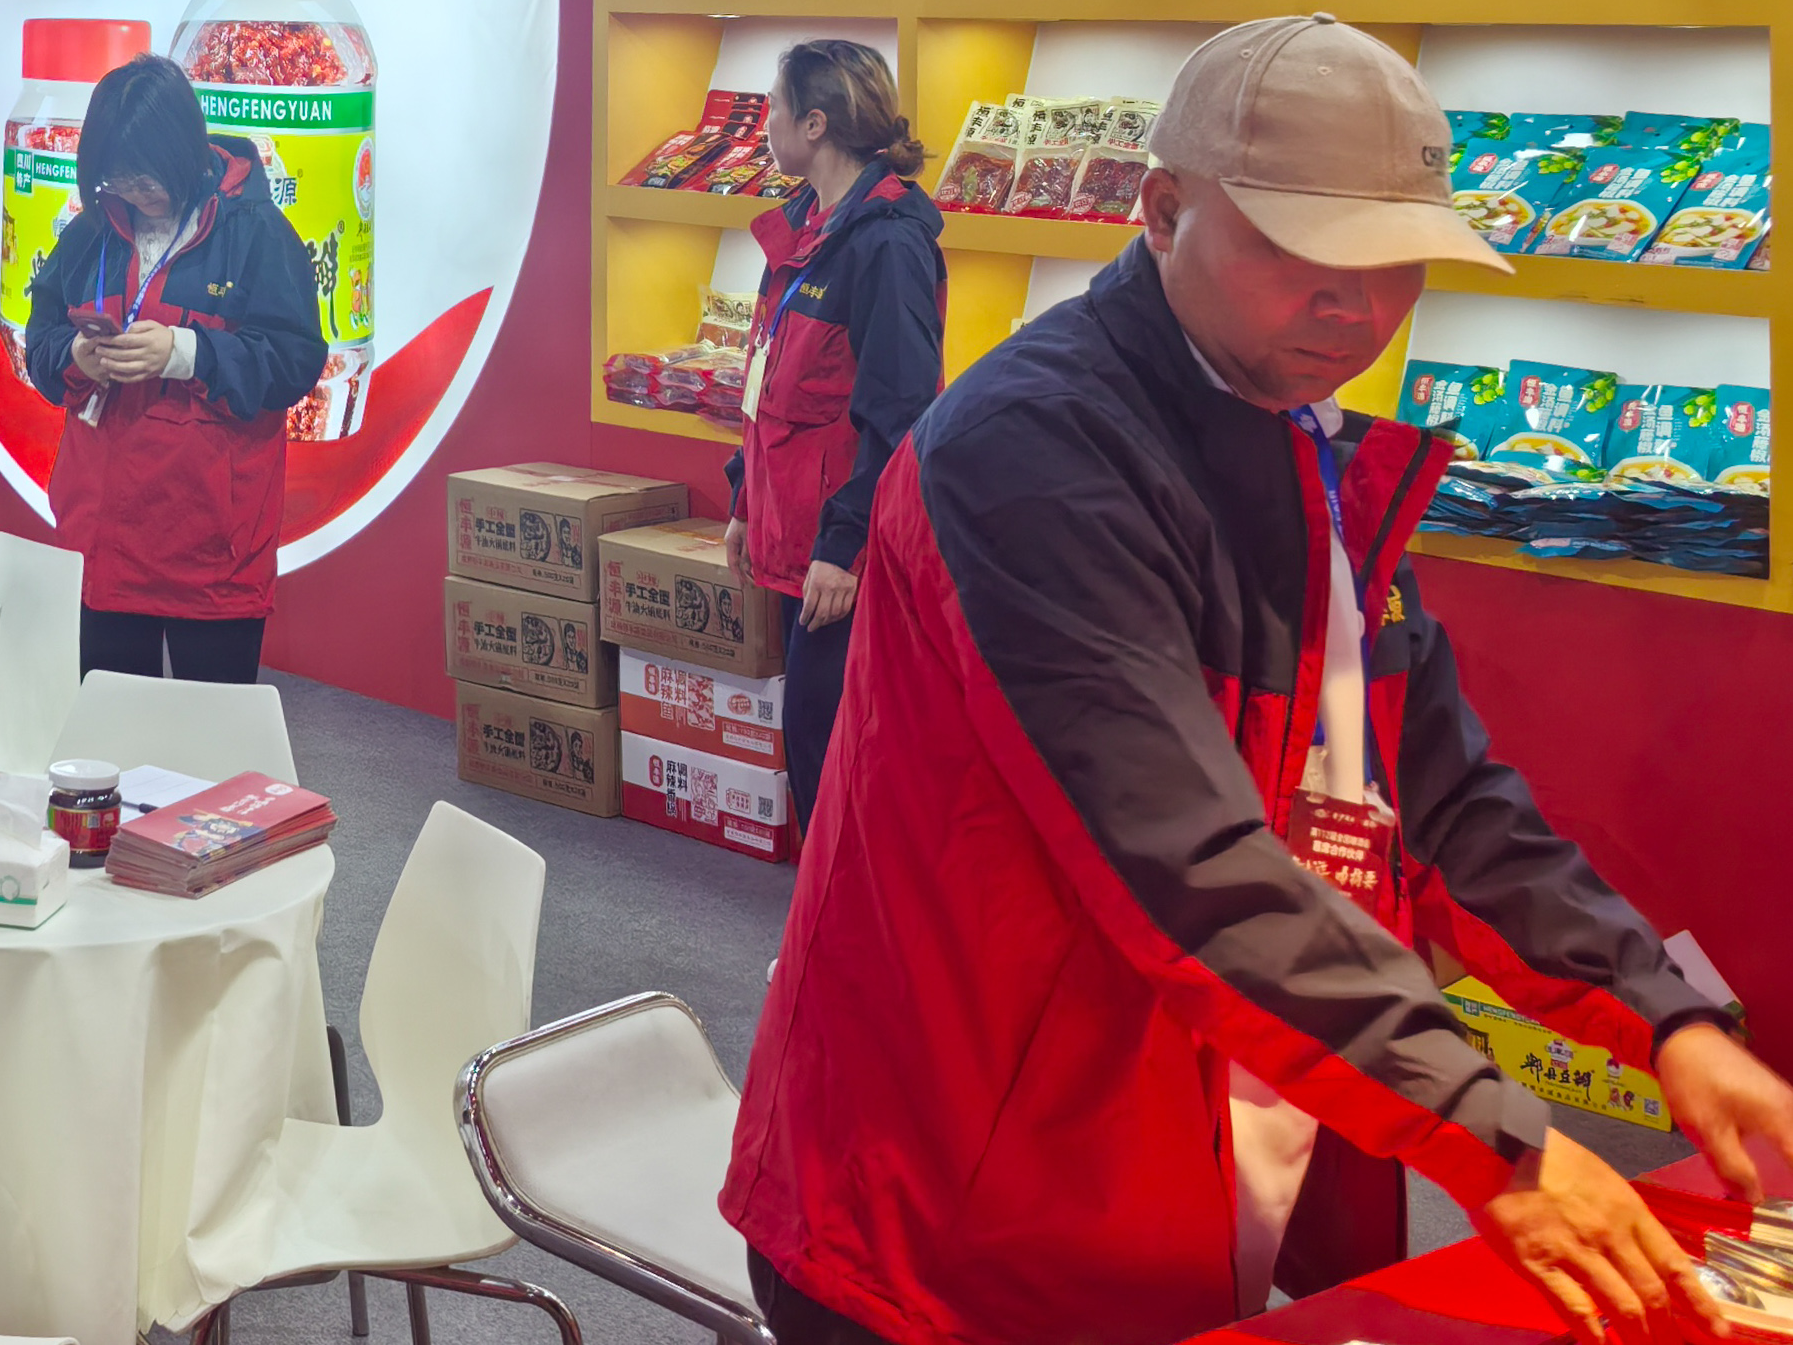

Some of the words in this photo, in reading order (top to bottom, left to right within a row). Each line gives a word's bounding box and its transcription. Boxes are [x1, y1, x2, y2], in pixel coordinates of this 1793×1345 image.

[200, 94, 333, 122] HENGFENGYUAN
[1520, 1052, 1594, 1102] 郫县豆瓣
